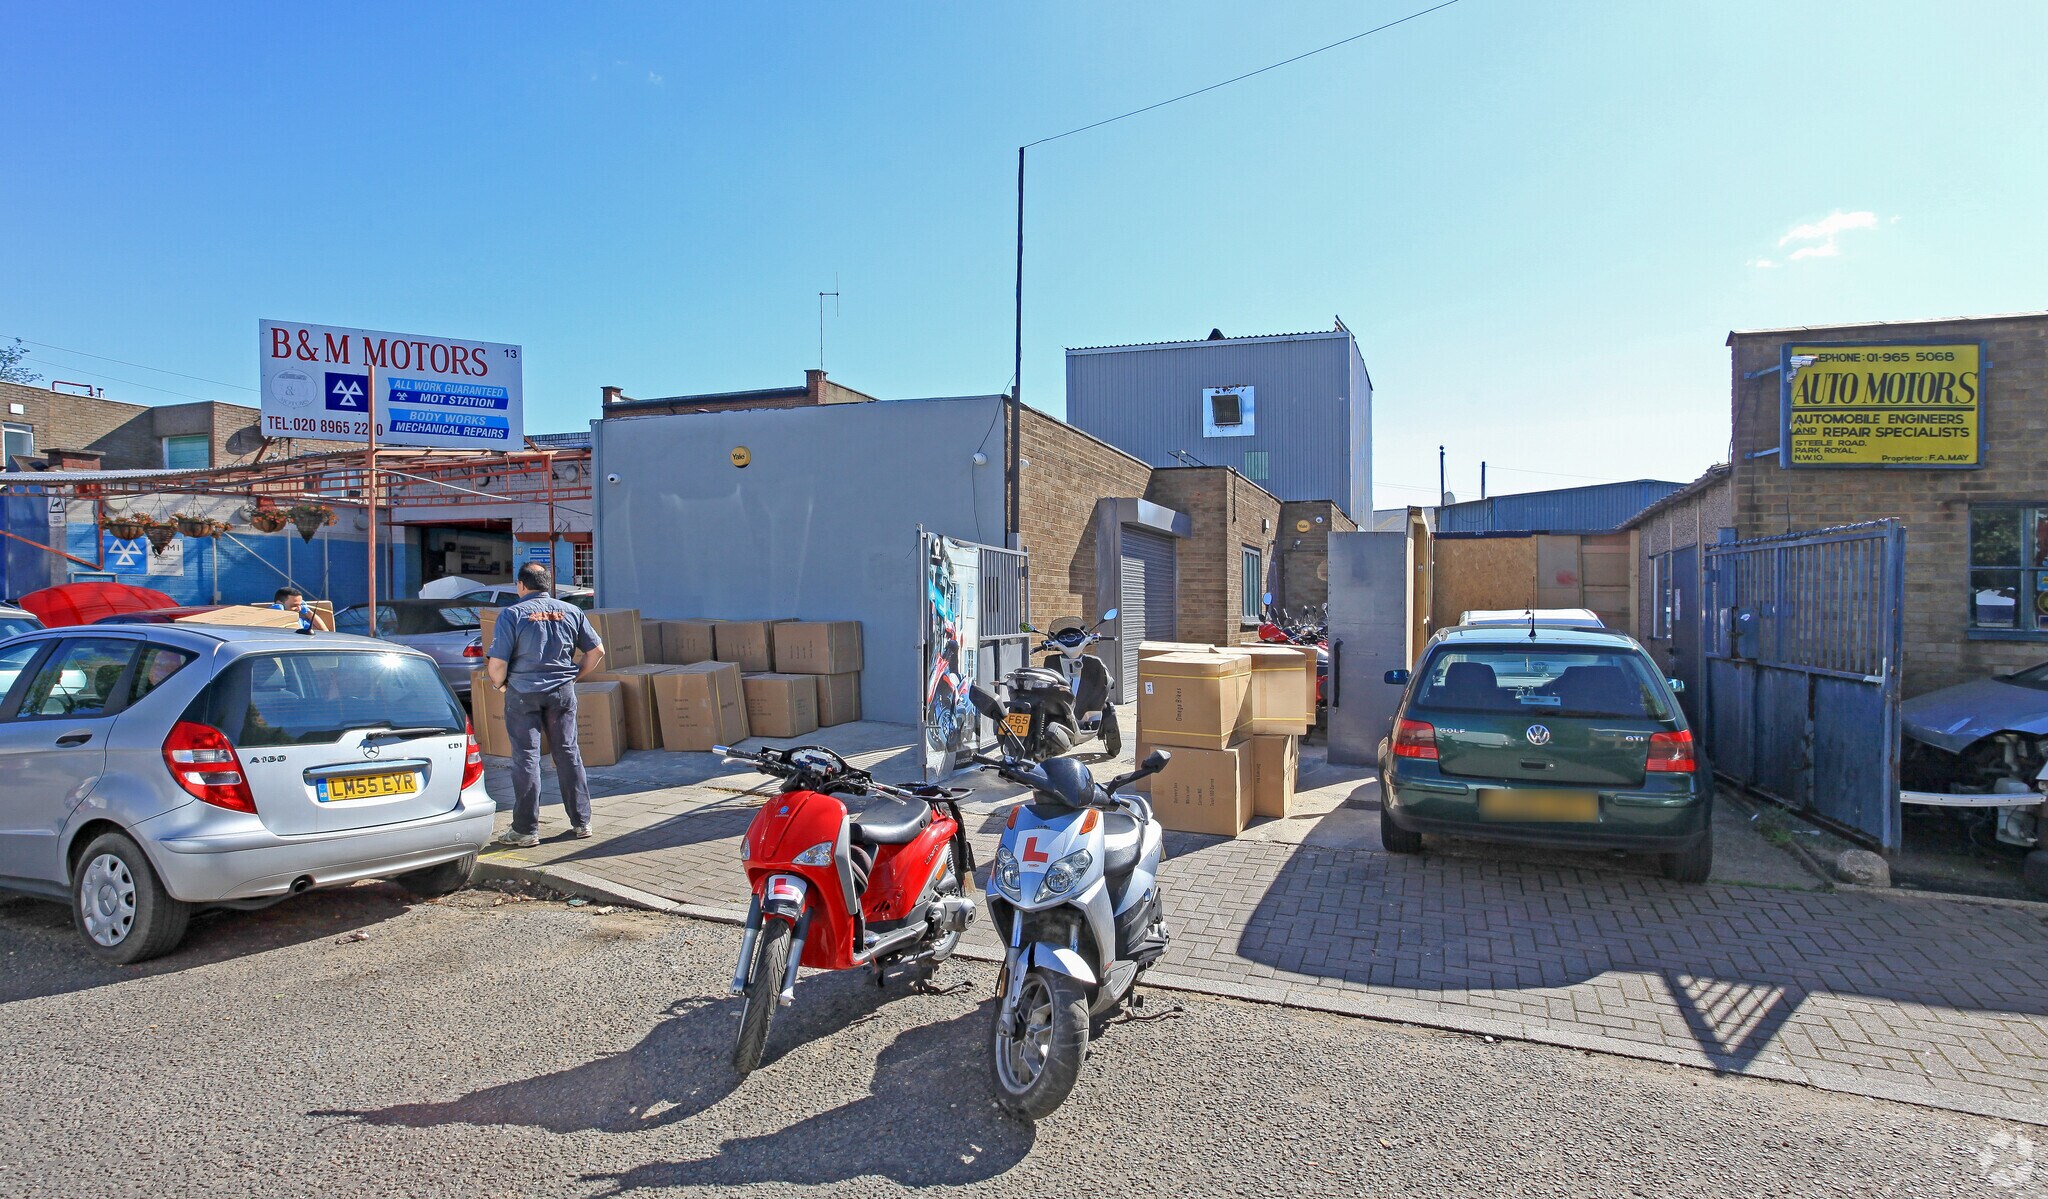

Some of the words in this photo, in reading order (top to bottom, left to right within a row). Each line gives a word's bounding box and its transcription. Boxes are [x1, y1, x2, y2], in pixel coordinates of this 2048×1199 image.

[271, 328, 351, 365] B&M
[362, 336, 488, 377] MOTORS
[504, 349, 518, 359] 13
[1916, 352, 1955, 362] 5068
[394, 379, 412, 390] ALL
[414, 381, 442, 393] WORK
[444, 384, 504, 397] GUARANTEED
[1792, 372, 1859, 405] AUTO
[1862, 371, 1978, 405] MOTORS
[419, 393, 445, 405] MOT
[448, 395, 495, 408] STATION
[409, 411, 441, 422] BODY
[444, 413, 487, 426] WORKS
[1794, 414, 1880, 425] AUTOMOBILE
[1888, 414, 1964, 425] ENGINEERS
[320, 418, 350, 434] 8965
[354, 421, 383, 437] 220
[395, 422, 461, 436] MECHANICAL
[462, 426, 504, 439] REPAIRS
[1795, 427, 1818, 435] AND
[1823, 427, 1871, 438] REPAIR
[1875, 427, 1970, 438] SPECIALISTS
[1005, 714, 1029, 724] F65
[330, 776, 379, 797] LM55
[383, 773, 415, 792] EYR
[1022, 836, 1048, 863] L
[774, 878, 799, 898] L
